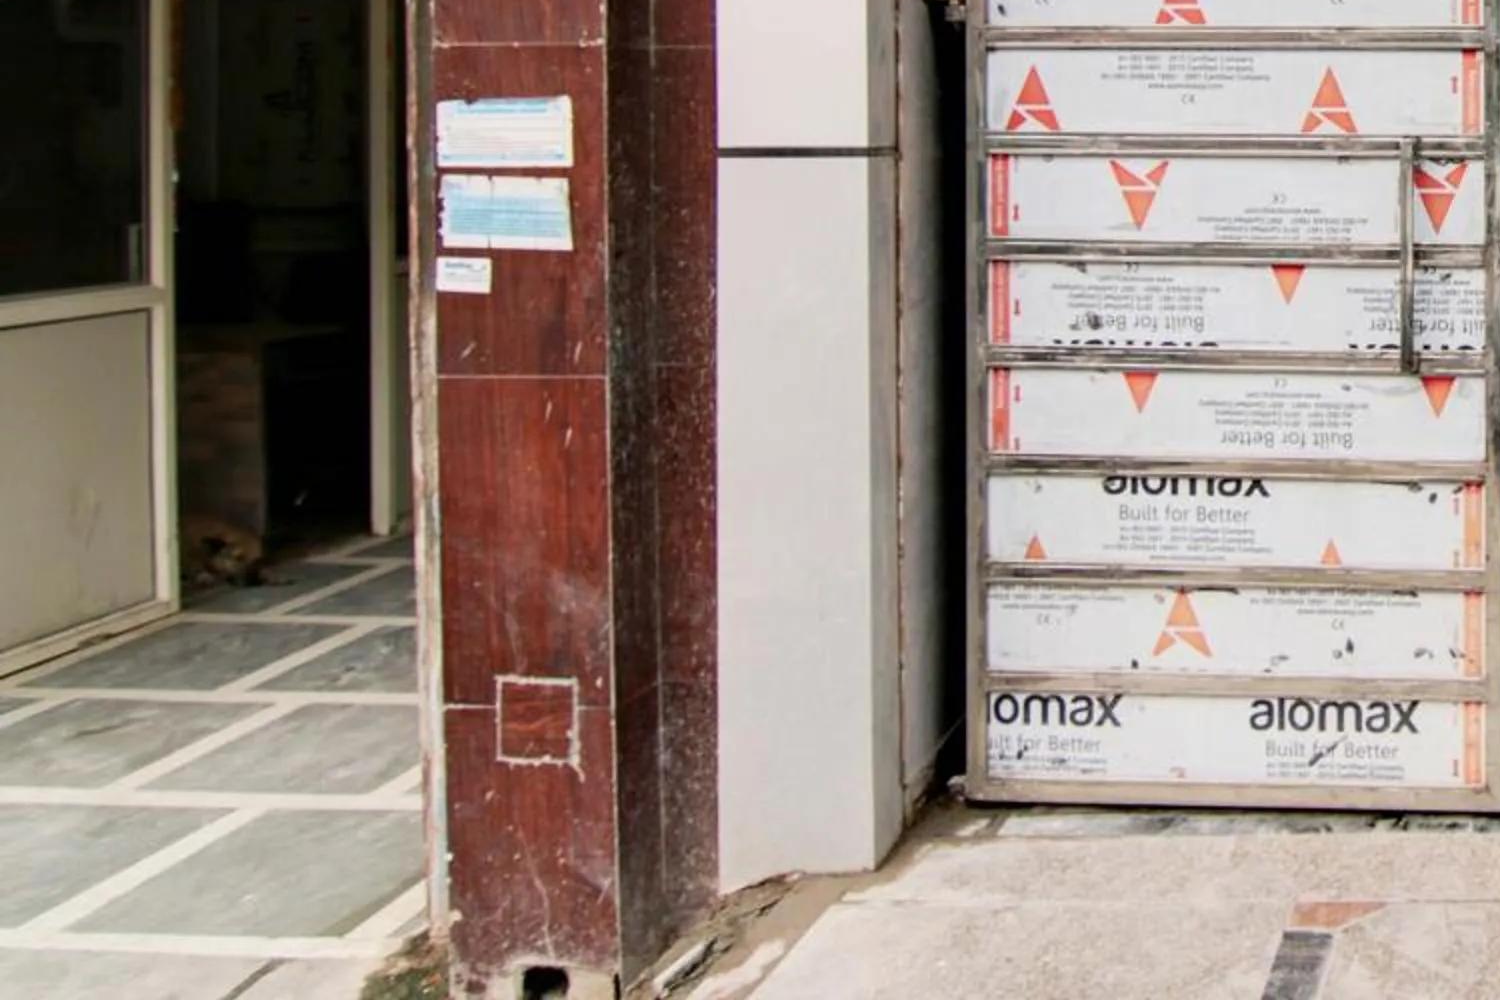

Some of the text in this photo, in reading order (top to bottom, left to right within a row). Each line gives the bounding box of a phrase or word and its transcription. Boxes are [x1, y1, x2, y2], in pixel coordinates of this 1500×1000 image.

[1133, 315, 1157, 333] for
[1165, 315, 1204, 333] Built
[1220, 431, 1354, 449] Built for Better
[1119, 504, 1250, 523] Built for Better
[1249, 700, 1420, 734] alomax
[1265, 740, 1306, 761] Built
[1344, 740, 1399, 761] Better
